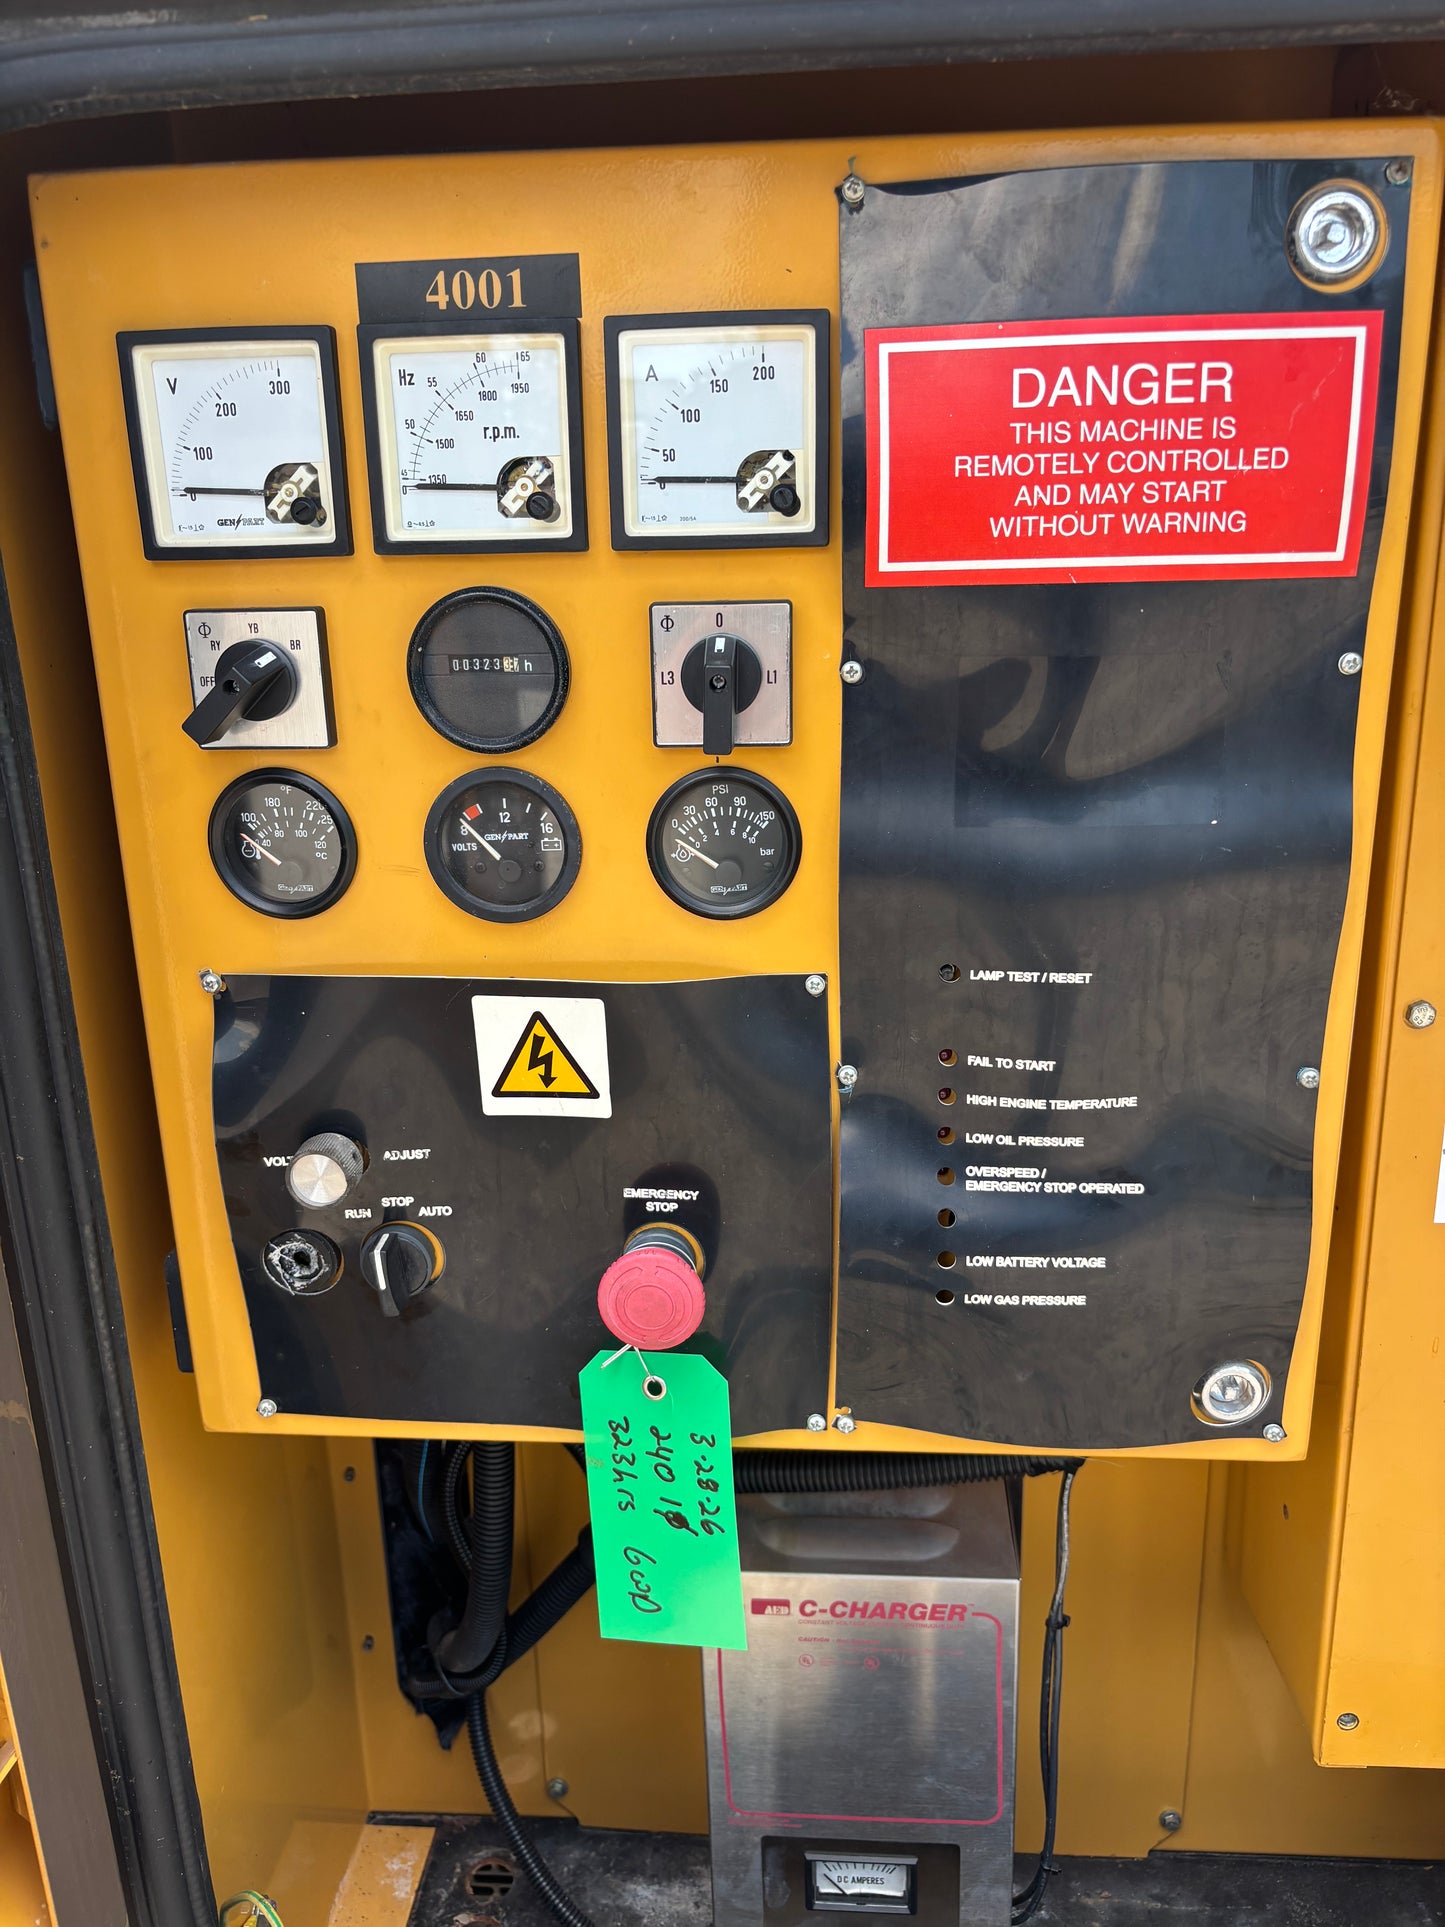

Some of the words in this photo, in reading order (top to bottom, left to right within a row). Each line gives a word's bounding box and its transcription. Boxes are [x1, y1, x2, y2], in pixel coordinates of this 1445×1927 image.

[425, 268, 527, 310] 4001
[475, 352, 487, 363] 60
[520, 351, 531, 362] 65
[398, 368, 416, 386] Hz
[645, 364, 659, 382] A
[752, 366, 775, 381] 200
[166, 378, 178, 395] V
[269, 380, 291, 395] 300
[427, 376, 438, 388] 55
[510, 382, 530, 394] 1950
[709, 379, 729, 393] 150
[1011, 361, 1234, 409] DANGER
[478, 390, 498, 402] 1800
[215, 403, 237, 417] 200
[454, 410, 474, 421] 1650
[680, 408, 701, 423] 100
[404, 419, 415, 430] 50
[1010, 420, 1072, 445] THIS
[1080, 417, 1204, 443] MACHINE
[1212, 416, 1237, 440] IS
[483, 425, 521, 442] r.p.m.
[435, 438, 455, 450] 1500
[193, 447, 213, 461] 100
[662, 448, 676, 462] 50
[954, 451, 1100, 478] REMOTELY
[1106, 447, 1290, 474] CONTROLLED
[428, 474, 447, 485] 1350
[1014, 483, 1071, 508] AND
[1079, 481, 1136, 506] MAY
[1141, 480, 1227, 504] START
[989, 513, 1117, 539] WITHOUT
[1121, 510, 1247, 535] WARNING
[248, 622, 259, 634] YB
[210, 640, 221, 651] RY
[290, 640, 301, 651] BR
[524, 659, 533, 672] h
[200, 676, 216, 687] OFF
[661, 670, 675, 685] L3
[766, 670, 777, 684] L1
[712, 784, 729, 795] PSI
[264, 797, 281, 808] 180
[705, 797, 718, 807] 60
[733, 796, 747, 807] 90
[683, 805, 696, 816] 30
[759, 811, 775, 821] 150
[240, 812, 257, 823] 100
[499, 812, 511, 823] 12
[671, 818, 679, 829] 0
[274, 830, 285, 838] 80
[295, 830, 308, 838] 100
[460, 825, 469, 836] 8
[540, 822, 554, 834] 16
[714, 828, 720, 836] 4
[730, 828, 736, 836] 6
[742, 831, 748, 839] 8
[748, 836, 756, 844] 10
[261, 840, 272, 848] 40
[314, 841, 327, 849] 120
[451, 842, 478, 852] VOLTS
[695, 841, 701, 849] 0
[759, 847, 775, 856] bar
[969, 970, 1005, 982] LAMP
[1007, 971, 1040, 983] TEST
[1049, 972, 1093, 984] RESET
[967, 1055, 993, 1068] FAIL
[995, 1057, 1013, 1069] TO
[1015, 1058, 1056, 1072] START
[966, 1094, 997, 1107] HIGH
[999, 1097, 1047, 1110] ENGINE
[1049, 1096, 1138, 1111] TEMPERATURE
[965, 1132, 994, 1145] LOW
[995, 1134, 1016, 1146] OIL
[1018, 1135, 1085, 1147] PRESSURE
[383, 1148, 431, 1161] ADJUST
[965, 1165, 1040, 1178] OVERSPEED
[965, 1180, 1042, 1193] EMERGENCY
[1043, 1182, 1077, 1194] STOP
[1079, 1183, 1145, 1195] OPERATED
[623, 1187, 700, 1201] EMERGENCY
[381, 1196, 415, 1207] STOP
[645, 1201, 679, 1213] STOP
[344, 1208, 372, 1219] RUN
[418, 1205, 453, 1217] AUTO
[965, 1256, 994, 1267] LOW
[995, 1256, 1050, 1268] BATTERY
[1051, 1257, 1106, 1269] VOLTAGE
[964, 1294, 992, 1305] LOW
[994, 1294, 1020, 1306] GAS
[1021, 1295, 1087, 1307] PRESSURE
[645, 1425, 676, 1484] 240
[798, 1599, 968, 1622] C-CHARGER
[850, 1876, 885, 1885] AMPERES
